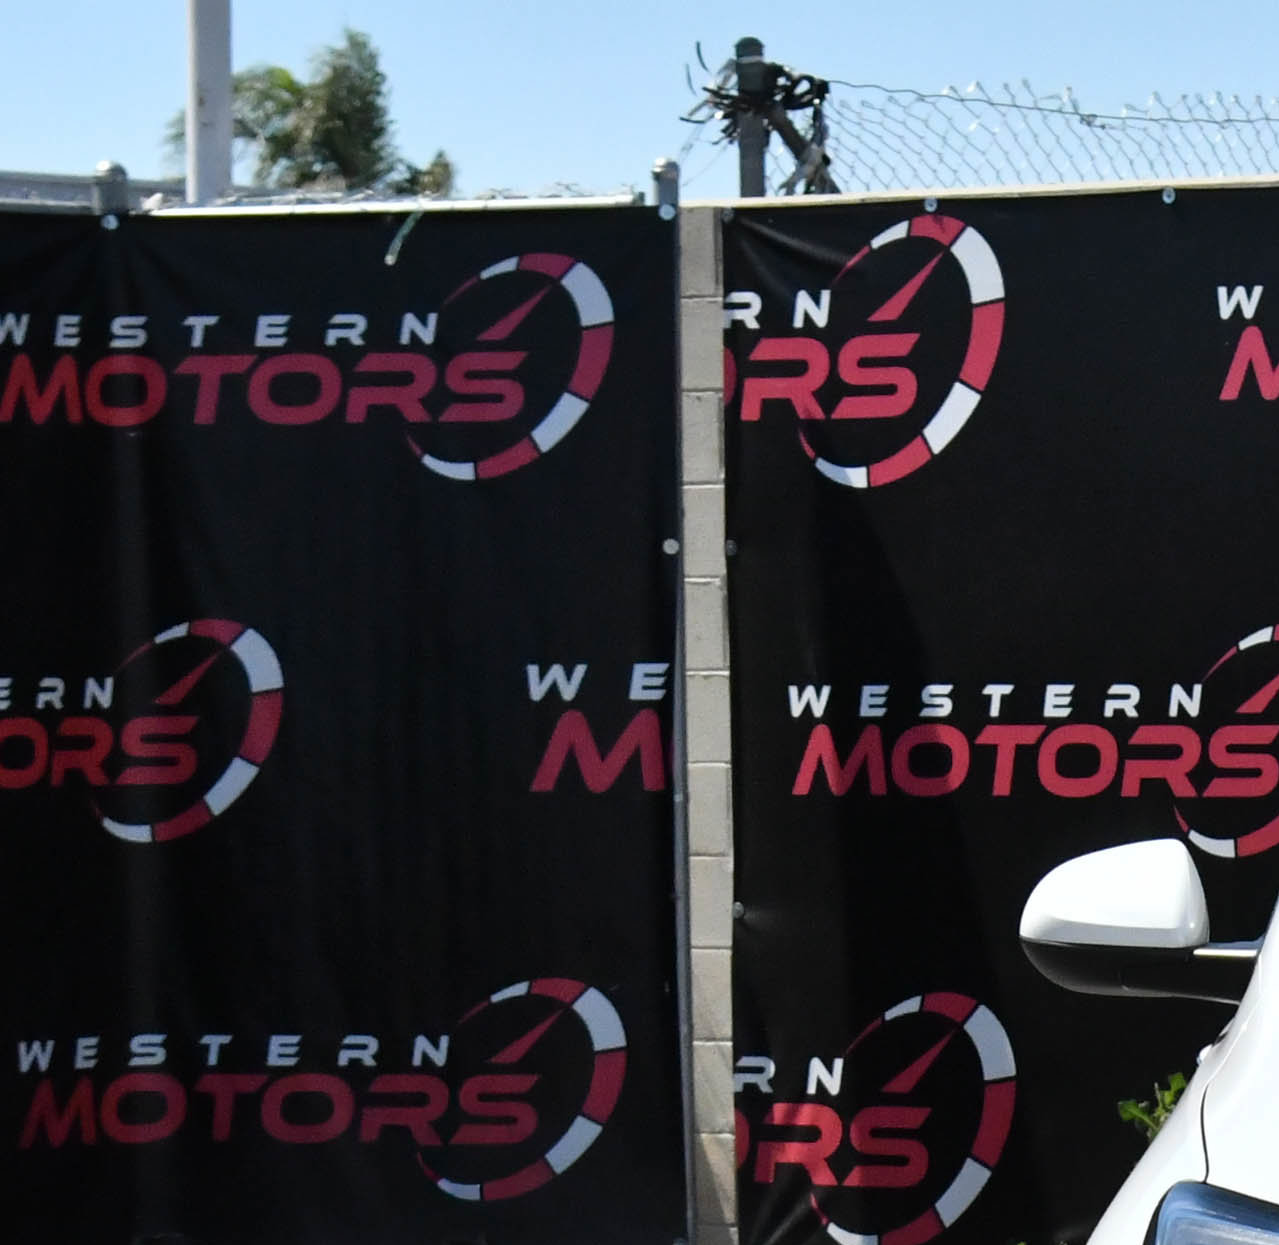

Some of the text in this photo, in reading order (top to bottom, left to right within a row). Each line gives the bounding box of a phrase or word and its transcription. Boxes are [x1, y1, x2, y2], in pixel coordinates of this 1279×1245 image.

[0, 313, 437, 347] WESTERN
[0, 352, 528, 426] MOTORS
[789, 684, 1202, 718] WESTERN
[21, 1036, 448, 1071] WESTERN
[20, 1072, 540, 1148] MOTORS
